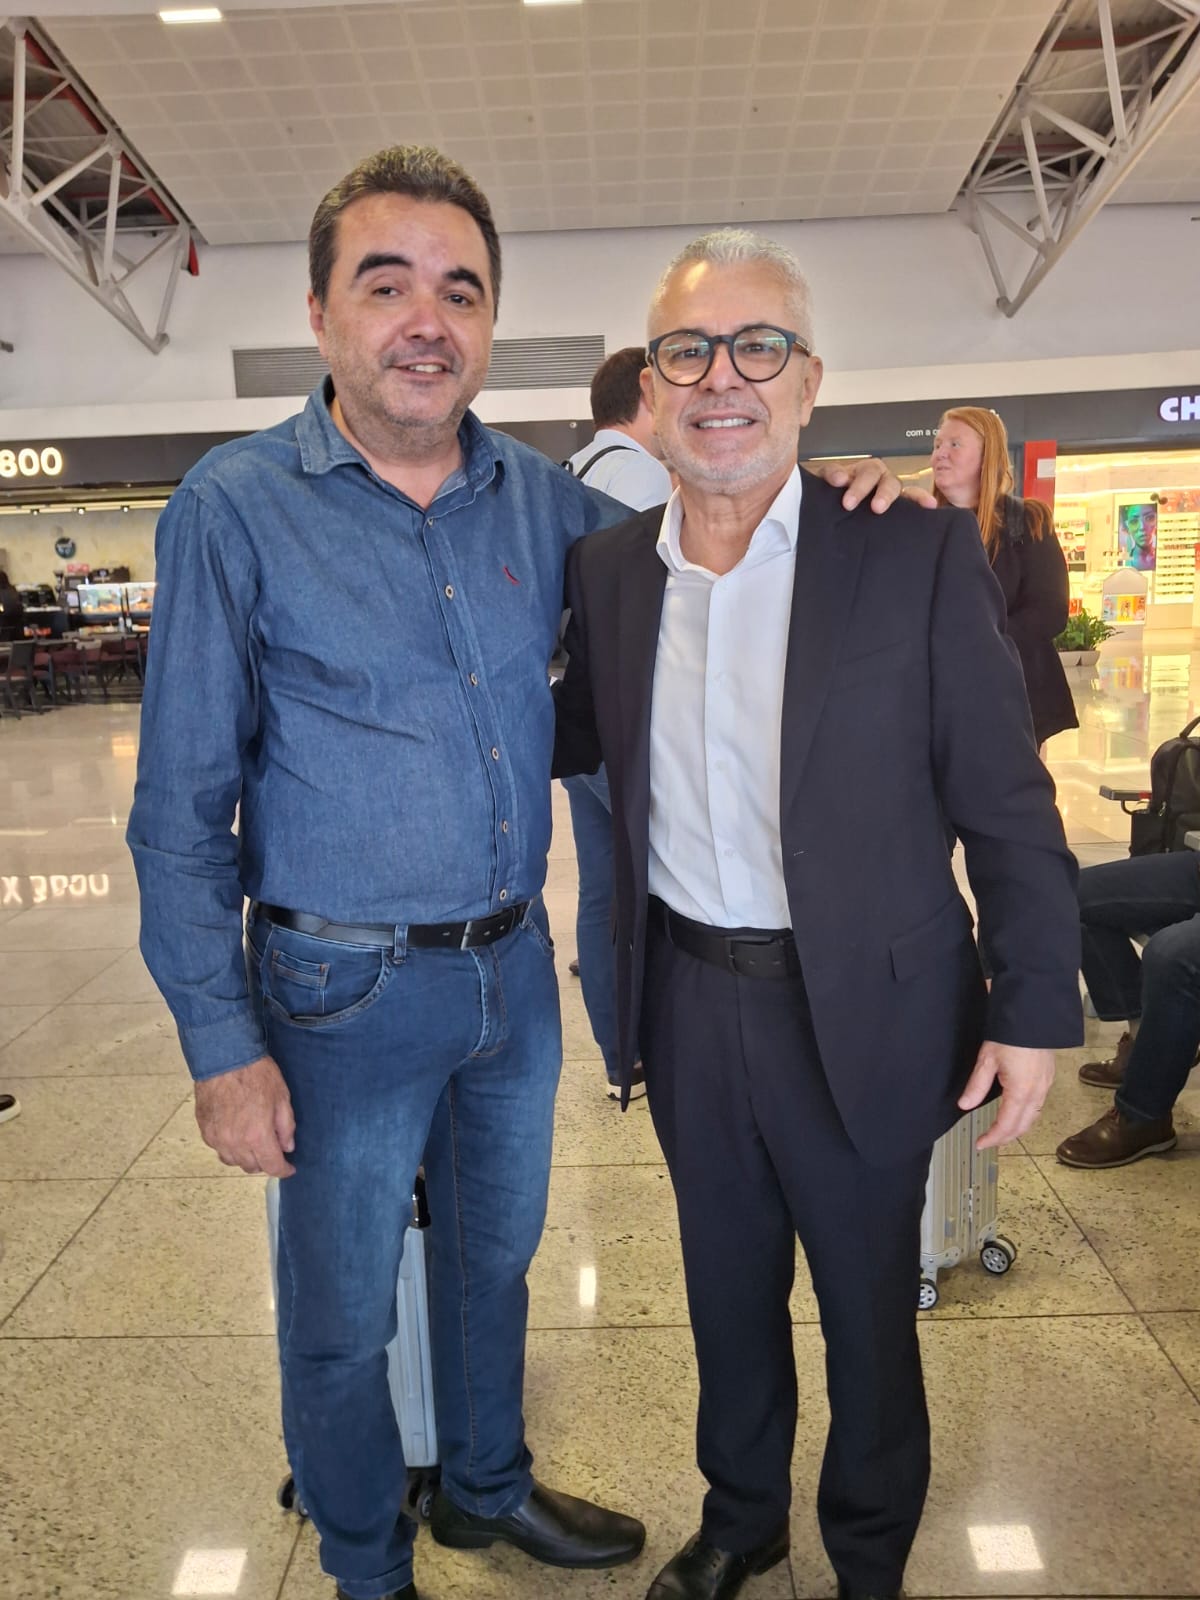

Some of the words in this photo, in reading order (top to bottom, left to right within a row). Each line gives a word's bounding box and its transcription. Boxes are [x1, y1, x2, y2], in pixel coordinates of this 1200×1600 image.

[1159, 396, 1200, 421] CH
[905, 429, 923, 437] com
[0, 446, 62, 476] 800
